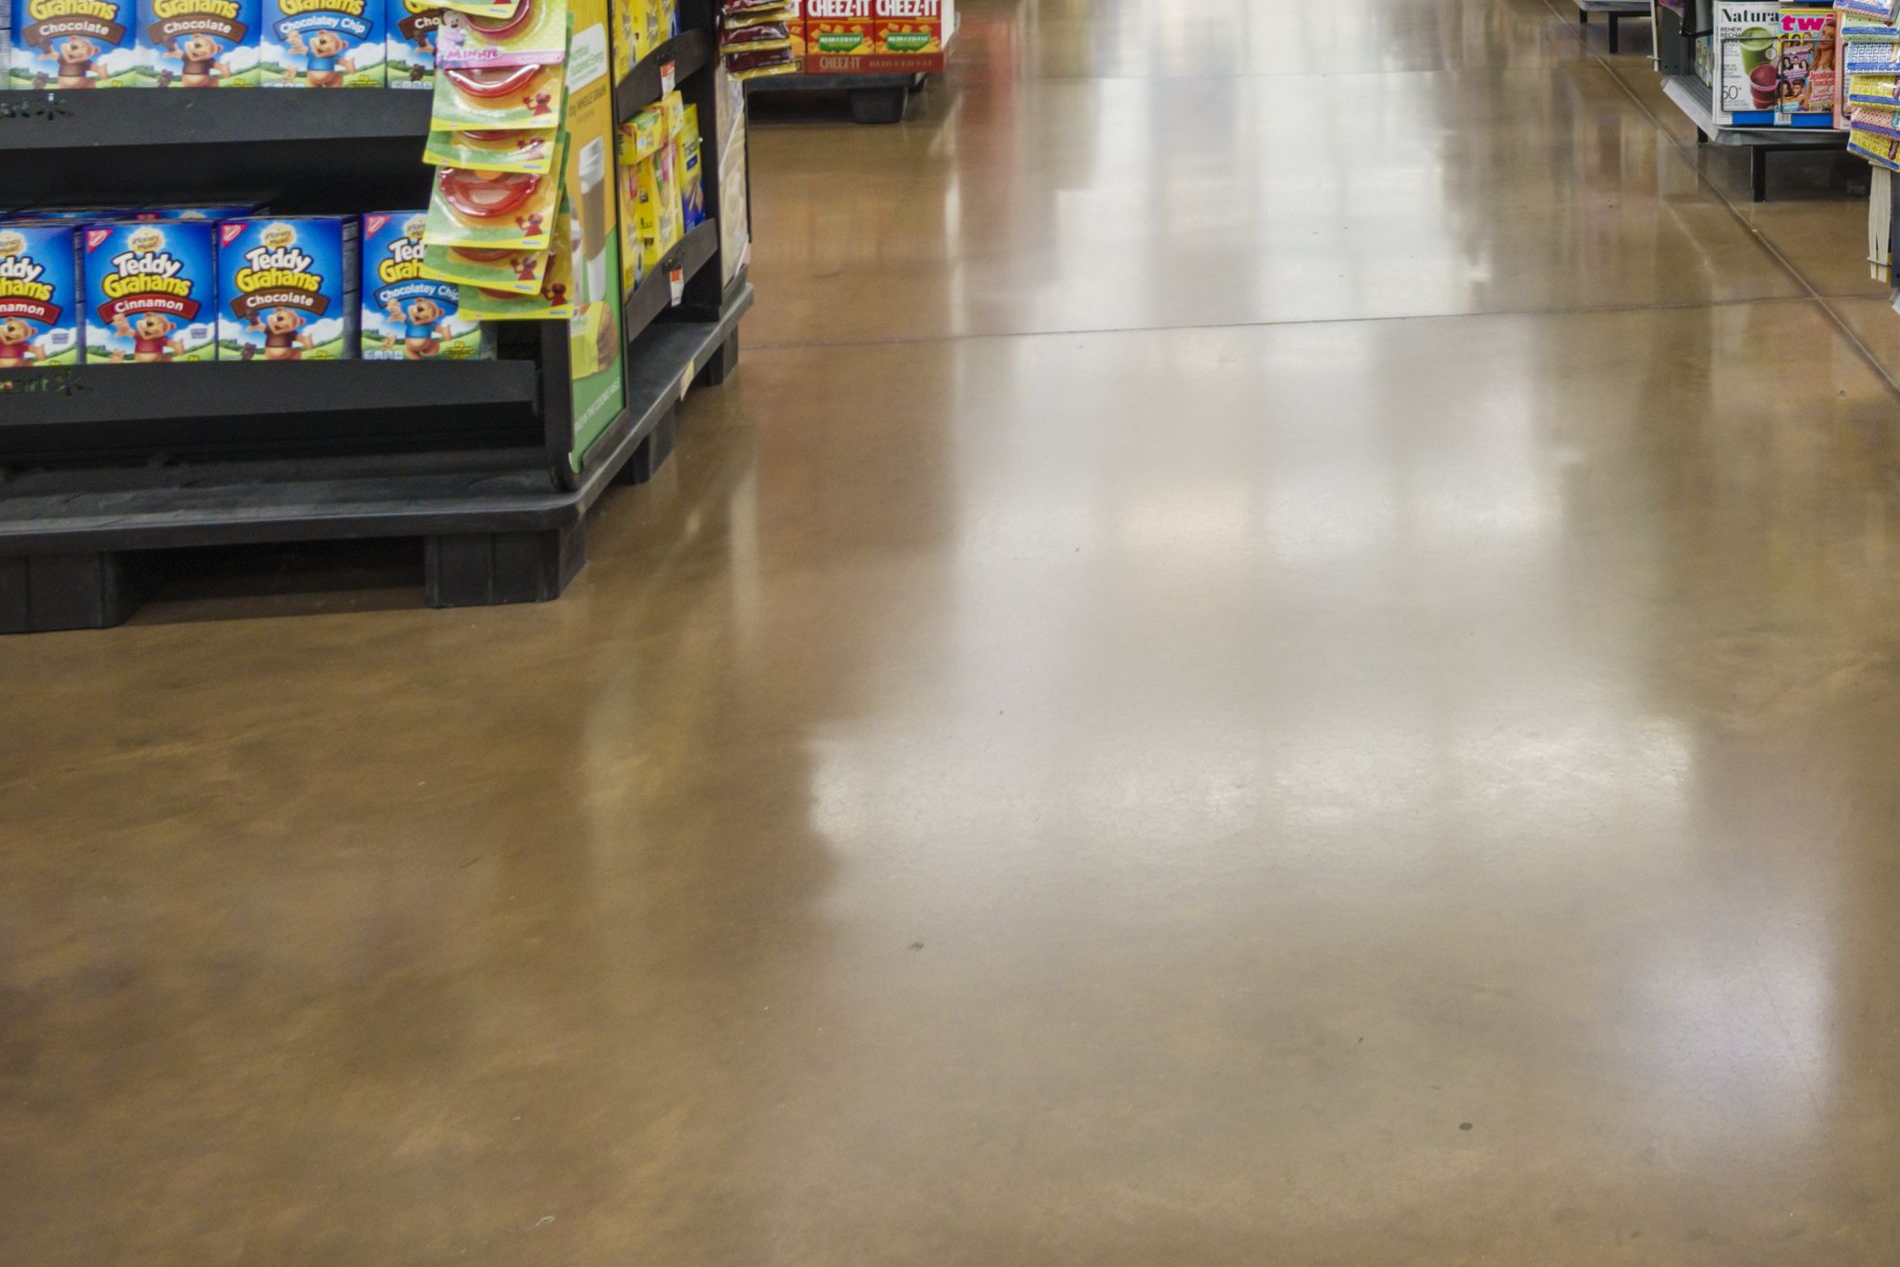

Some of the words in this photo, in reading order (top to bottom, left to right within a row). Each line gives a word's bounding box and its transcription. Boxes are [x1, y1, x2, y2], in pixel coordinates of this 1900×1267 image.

[1723, 9, 1779, 22] Natura
[39, 22, 110, 36] Chocolate
[280, 16, 339, 33] Chocolatey
[247, 291, 314, 308] Chocolate
